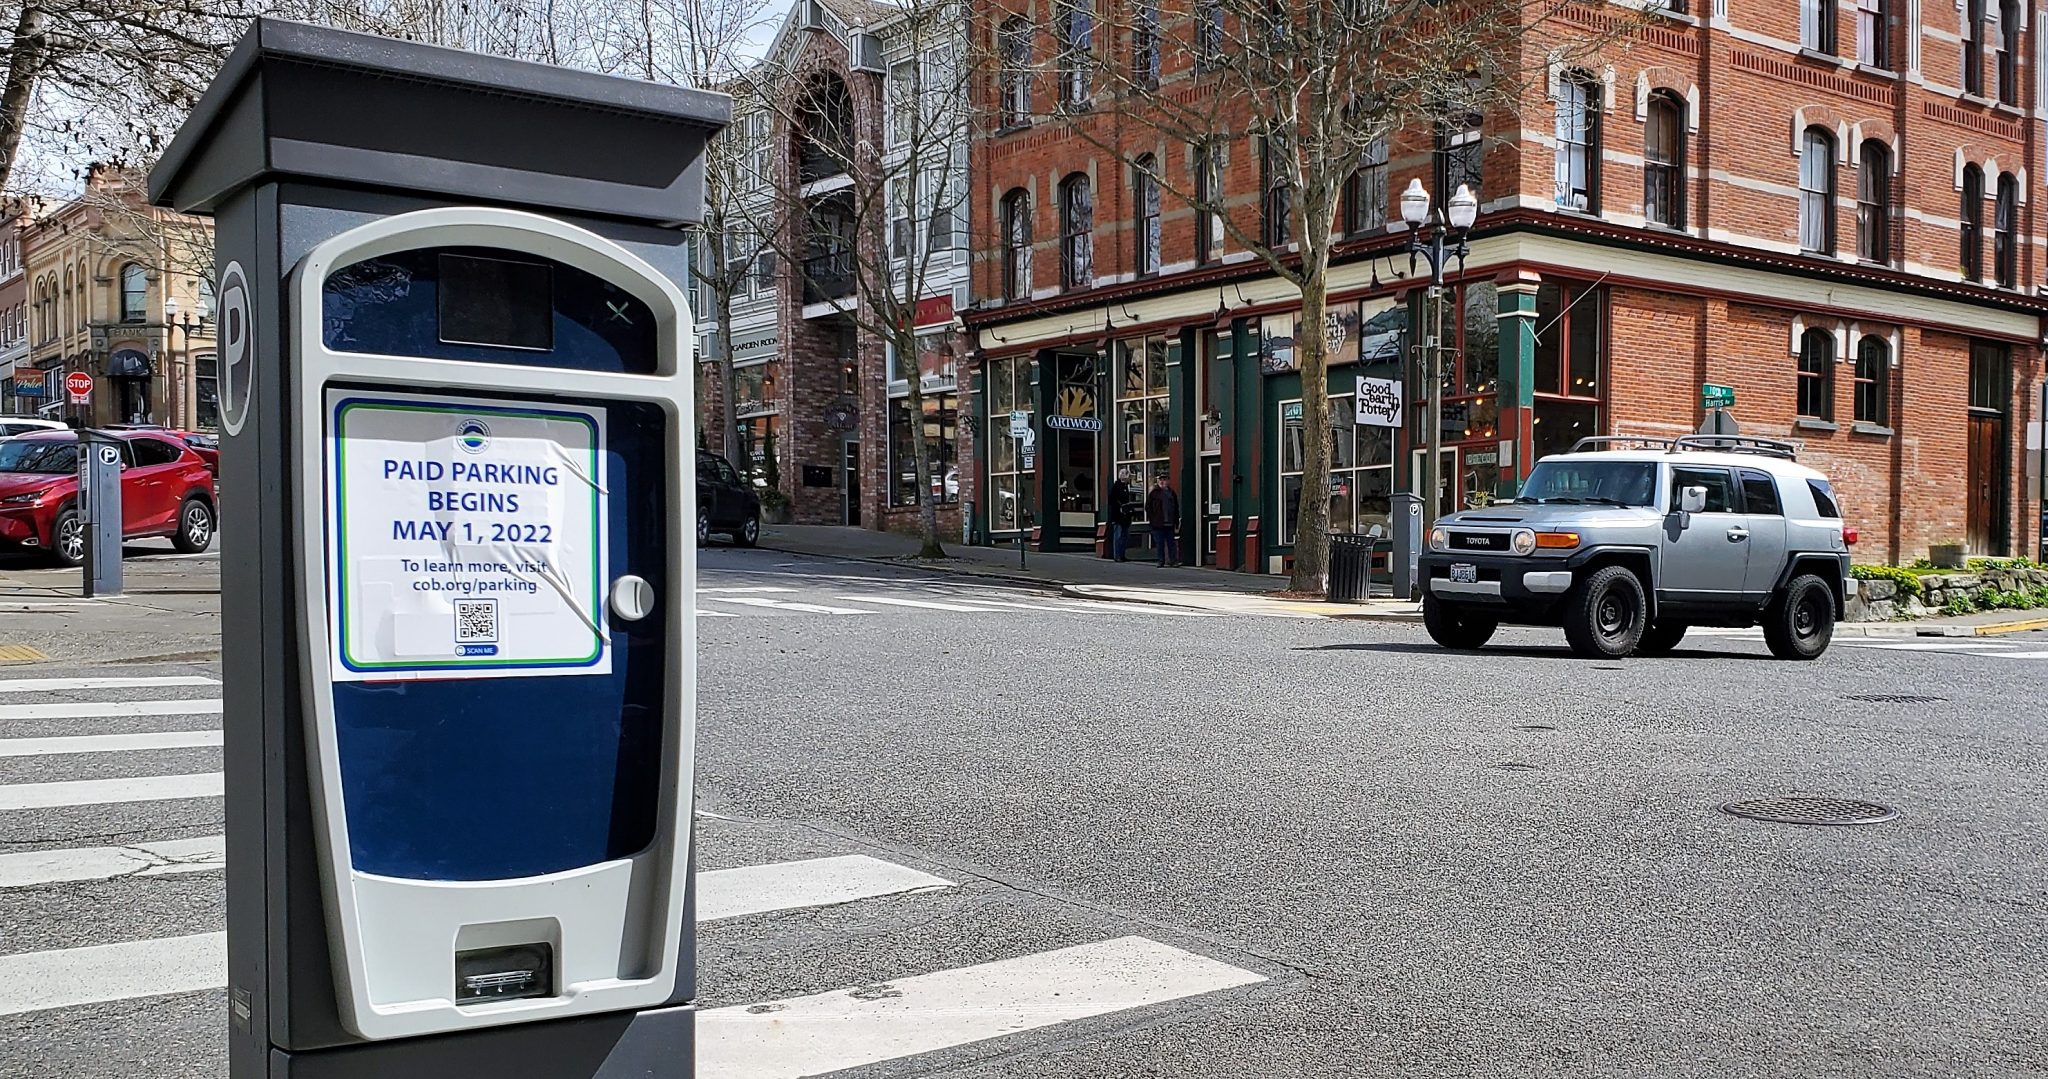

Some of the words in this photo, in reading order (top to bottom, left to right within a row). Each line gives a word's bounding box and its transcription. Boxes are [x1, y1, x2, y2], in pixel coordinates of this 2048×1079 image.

[732, 341, 759, 352] GARDEN
[68, 379, 91, 388] STOP
[1361, 382, 1391, 396] Good
[1369, 392, 1399, 408] earth
[1011, 412, 1016, 420] 2
[1359, 398, 1400, 423] Pottery
[1050, 416, 1101, 430] ARTWOOD
[384, 459, 444, 481] PAID
[452, 462, 558, 485] PARKING
[428, 491, 519, 513] BEGINS
[393, 520, 453, 541] MAY
[463, 522, 484, 545] 1,
[491, 523, 553, 543] 2022
[1466, 537, 1490, 545] TOYOTA
[401, 559, 420, 572] To
[423, 559, 463, 572] learn
[468, 561, 512, 574] more,
[515, 560, 548, 573] visit
[412, 578, 538, 594] cob.org/parking
